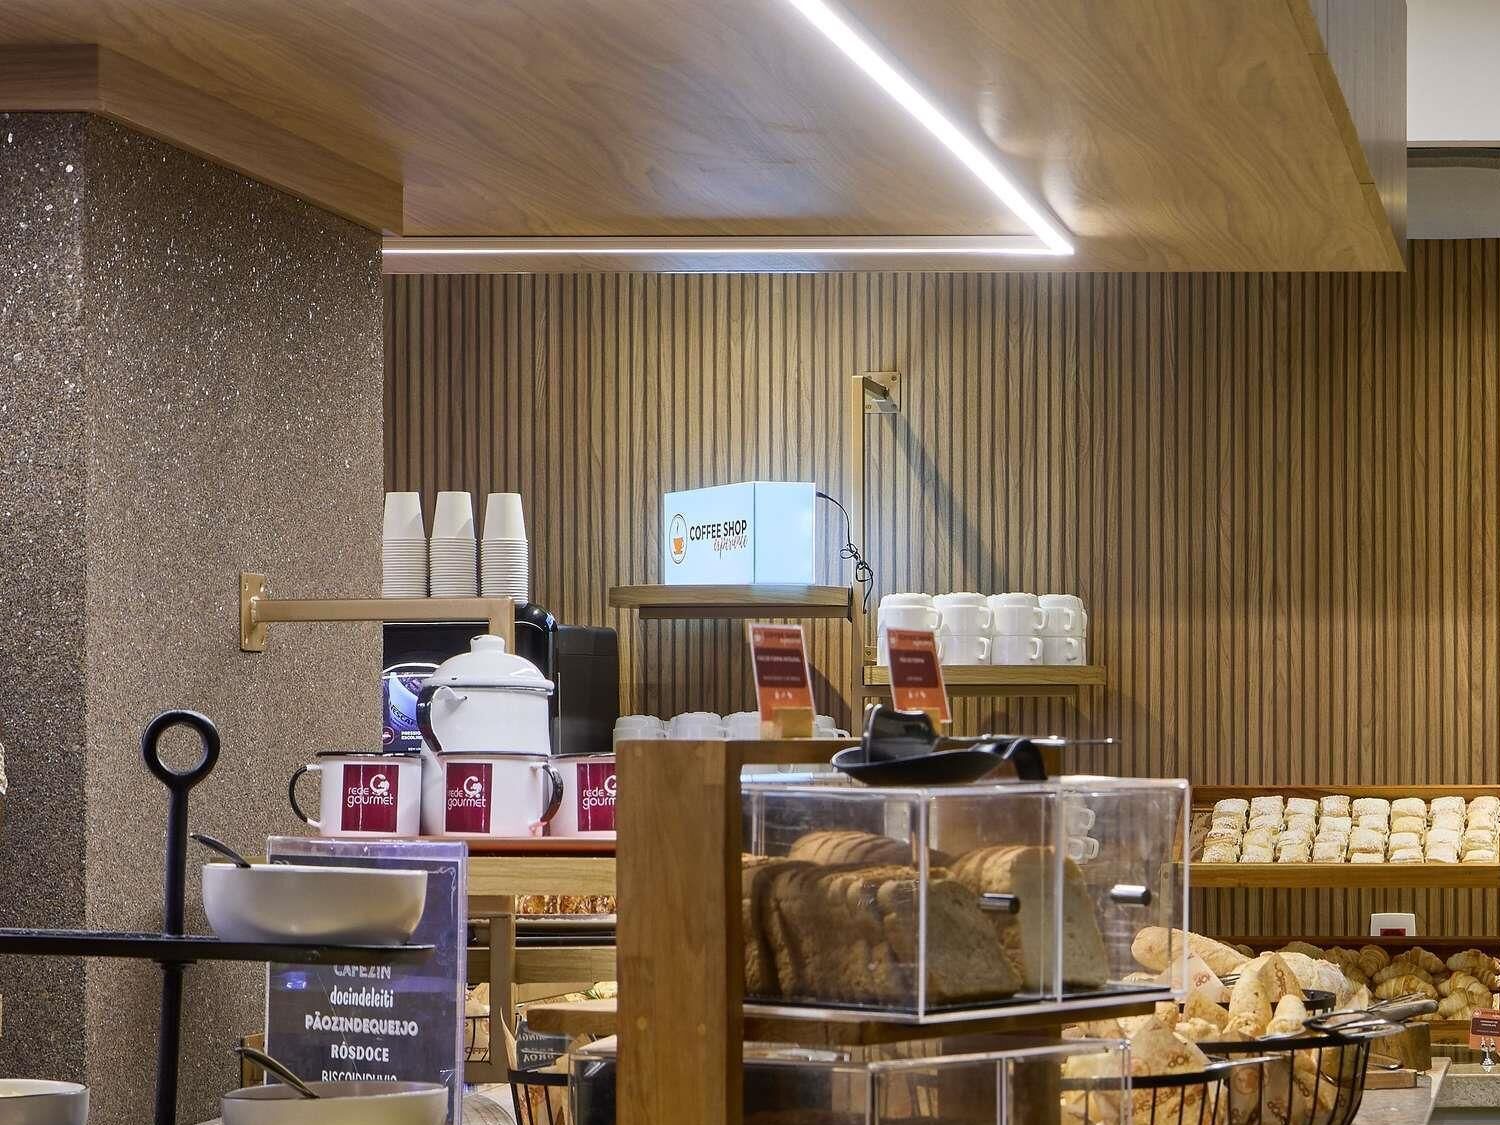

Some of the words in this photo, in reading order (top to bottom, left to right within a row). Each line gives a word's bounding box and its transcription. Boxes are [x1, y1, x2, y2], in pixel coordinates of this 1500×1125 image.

[689, 523, 721, 541] COFFEE
[723, 519, 747, 537] SHOP
[448, 787, 463, 797] rede
[583, 786, 604, 797] rede
[347, 794, 393, 808] gourmet
[447, 796, 486, 810] gourmet
[330, 985, 394, 1008] docindeleiti
[305, 1011, 419, 1037] PÃOZINDEQUEIJO
